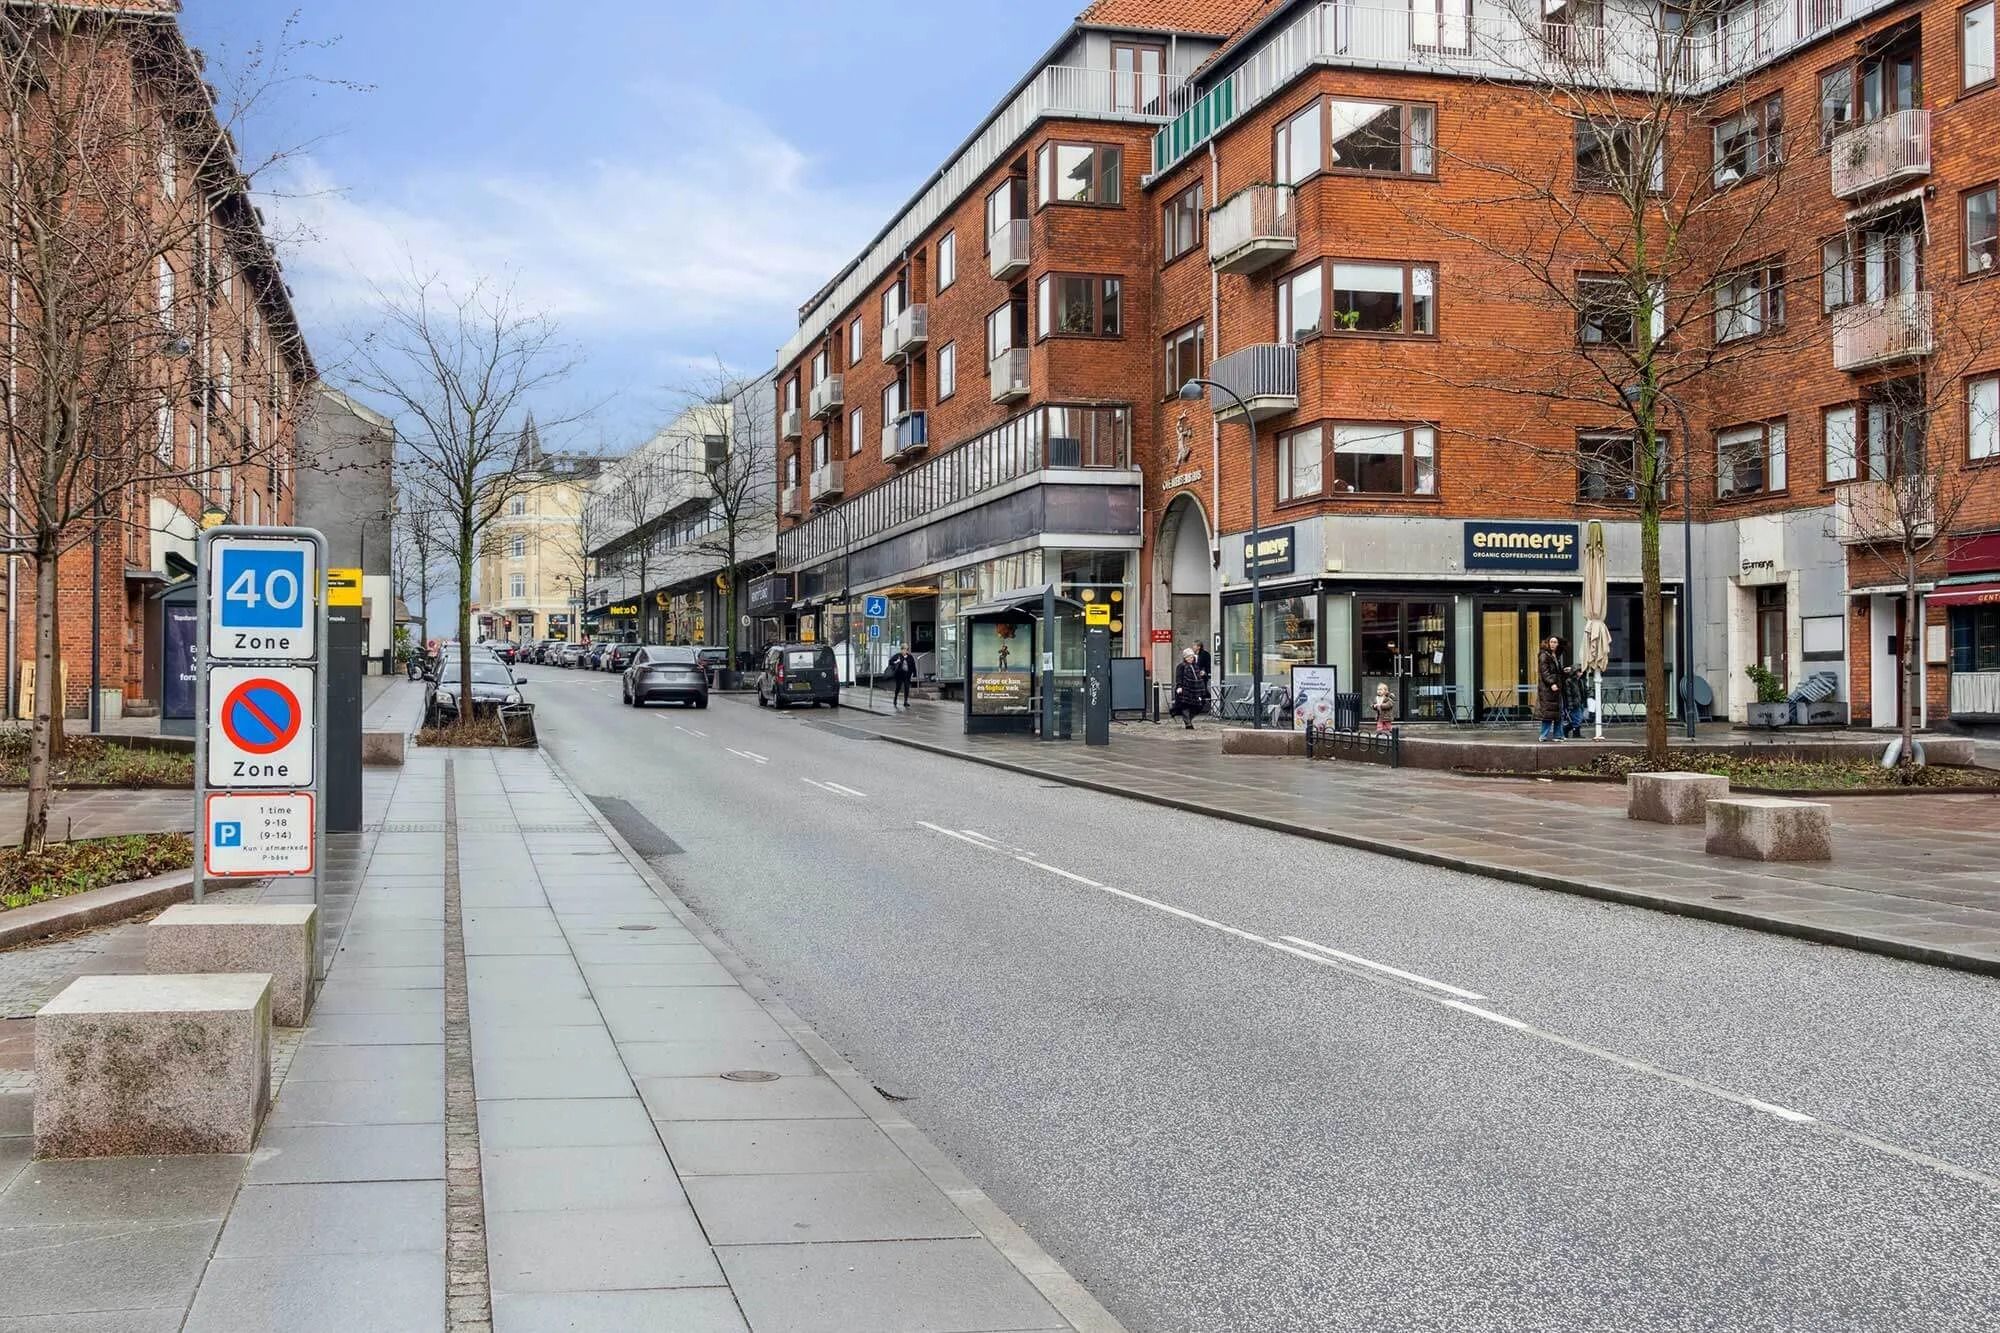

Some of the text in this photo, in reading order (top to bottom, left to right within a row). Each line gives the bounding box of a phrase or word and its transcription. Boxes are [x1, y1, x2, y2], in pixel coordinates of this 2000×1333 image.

[1473, 532, 1573, 553] emmerys
[225, 568, 298, 610] 40
[234, 633, 290, 650] Zone
[233, 761, 289, 777] Zone
[260, 806, 292, 814] 1 time
[264, 819, 287, 827] 9-18
[221, 825, 236, 844] P
[260, 831, 292, 840] (9-14)
